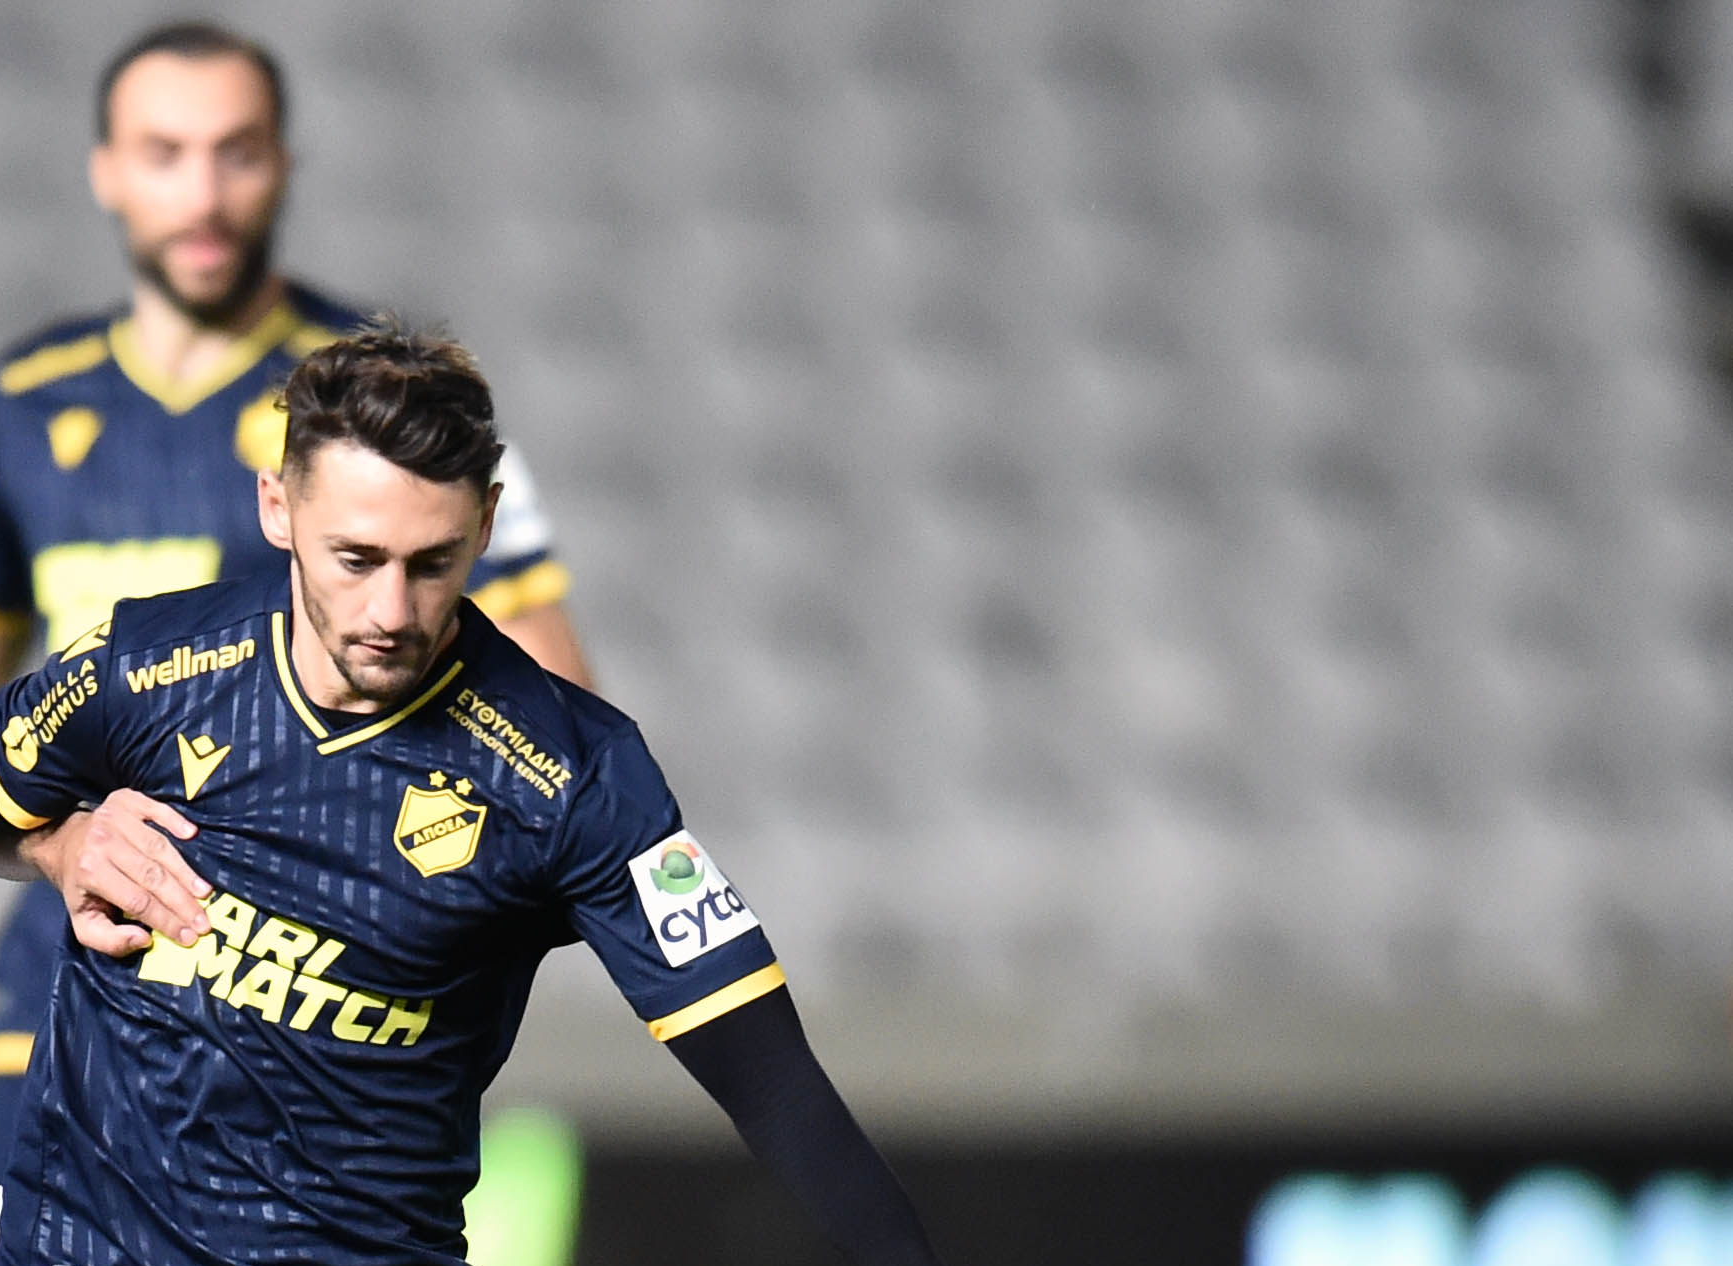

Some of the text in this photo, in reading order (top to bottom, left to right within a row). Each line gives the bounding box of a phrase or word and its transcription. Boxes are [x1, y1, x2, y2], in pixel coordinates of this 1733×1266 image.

[126, 638, 255, 694] wellman
[456, 688, 573, 790] ΕΥΘΥΜΙΑΔΗΣ
[197, 891, 347, 978] ARI
[659, 885, 747, 949] cyta
[138, 930, 435, 1047] MATCH
